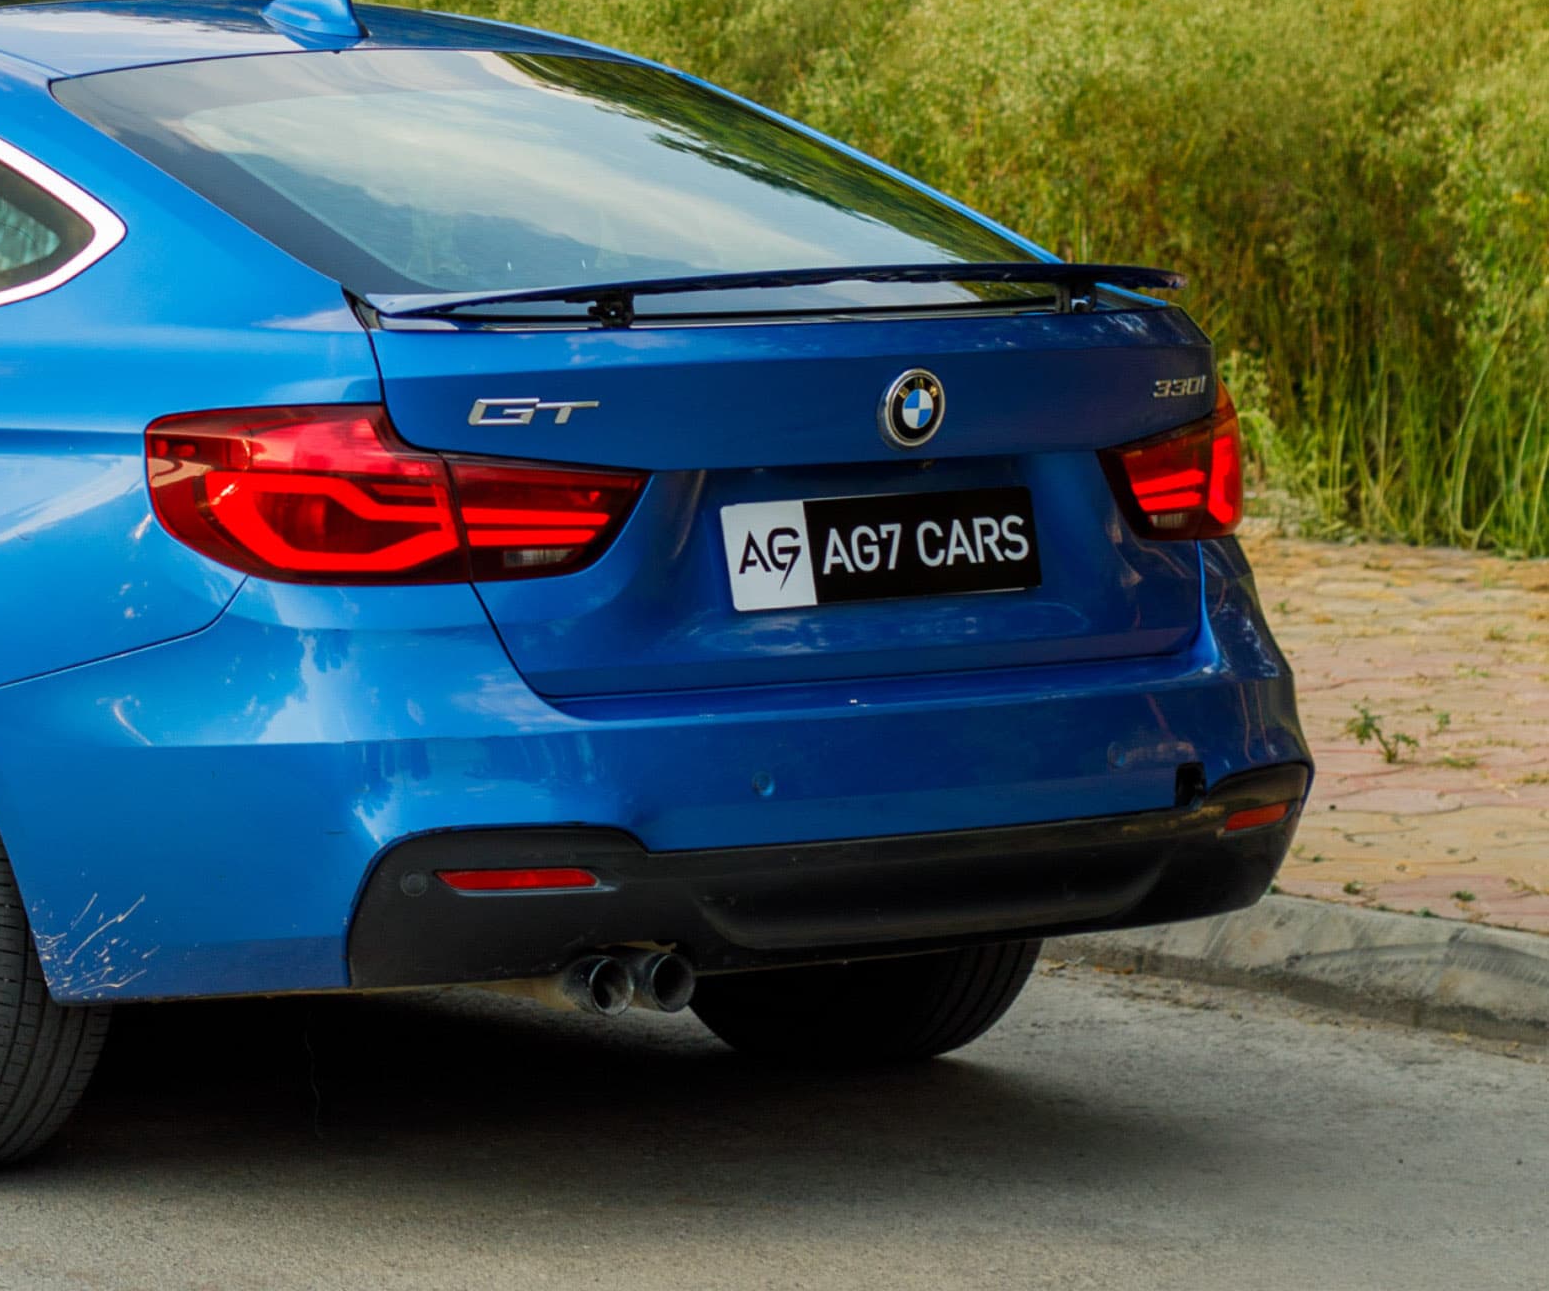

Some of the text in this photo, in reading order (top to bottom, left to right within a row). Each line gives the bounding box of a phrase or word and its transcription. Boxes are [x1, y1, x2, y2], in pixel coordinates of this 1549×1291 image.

[468, 398, 600, 425] GT
[823, 515, 1029, 575] AG7 CARS
